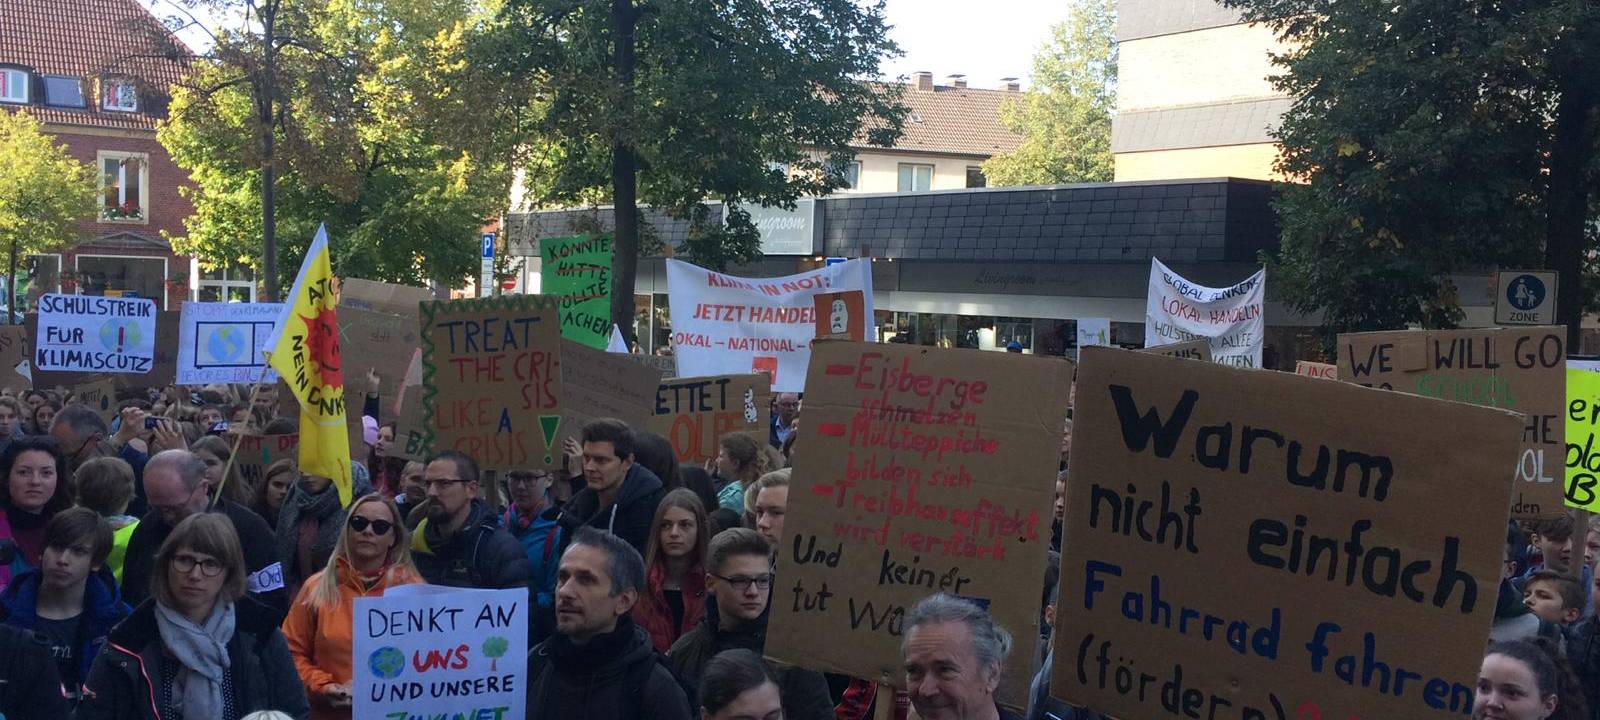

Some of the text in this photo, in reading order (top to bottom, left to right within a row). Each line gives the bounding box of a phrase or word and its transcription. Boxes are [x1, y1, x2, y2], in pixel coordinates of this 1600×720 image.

[484, 236, 491, 256] P
[40, 295, 150, 317] SCHULSTREIK
[562, 282, 609, 309] OLLTE
[1162, 296, 1260, 325] LOKAL HANDELN
[562, 311, 611, 338] ACHEN
[693, 303, 817, 324] JETZT HANDEL
[1510, 312, 1540, 322] ZONE
[436, 316, 541, 353] TREAT
[675, 331, 712, 349] OKAL
[728, 337, 796, 353] NATIONAL
[38, 348, 152, 372] KLIMASCUTZ
[292, 335, 309, 393] NEIN
[449, 355, 507, 383] THE
[1348, 334, 1563, 378] WE WILL GO
[521, 379, 558, 410] SIS
[656, 378, 730, 414] ETTET
[435, 397, 513, 433] LIKE A
[1522, 415, 1558, 445] HE
[454, 430, 528, 466] CRISIS
[1109, 383, 1394, 503] Warum
[846, 451, 973, 490] bilden sich
[1515, 449, 1553, 483] OL
[1511, 493, 1540, 515] den
[834, 514, 891, 546] wird
[1090, 481, 1479, 614] nicht einfach
[793, 534, 971, 596] Und keiner
[791, 581, 834, 613] tut
[368, 602, 518, 639] DENKT AN
[1084, 560, 1476, 715] Fahrrad fahren
[413, 643, 470, 673] UNS
[371, 674, 515, 703] UND UNSERE
